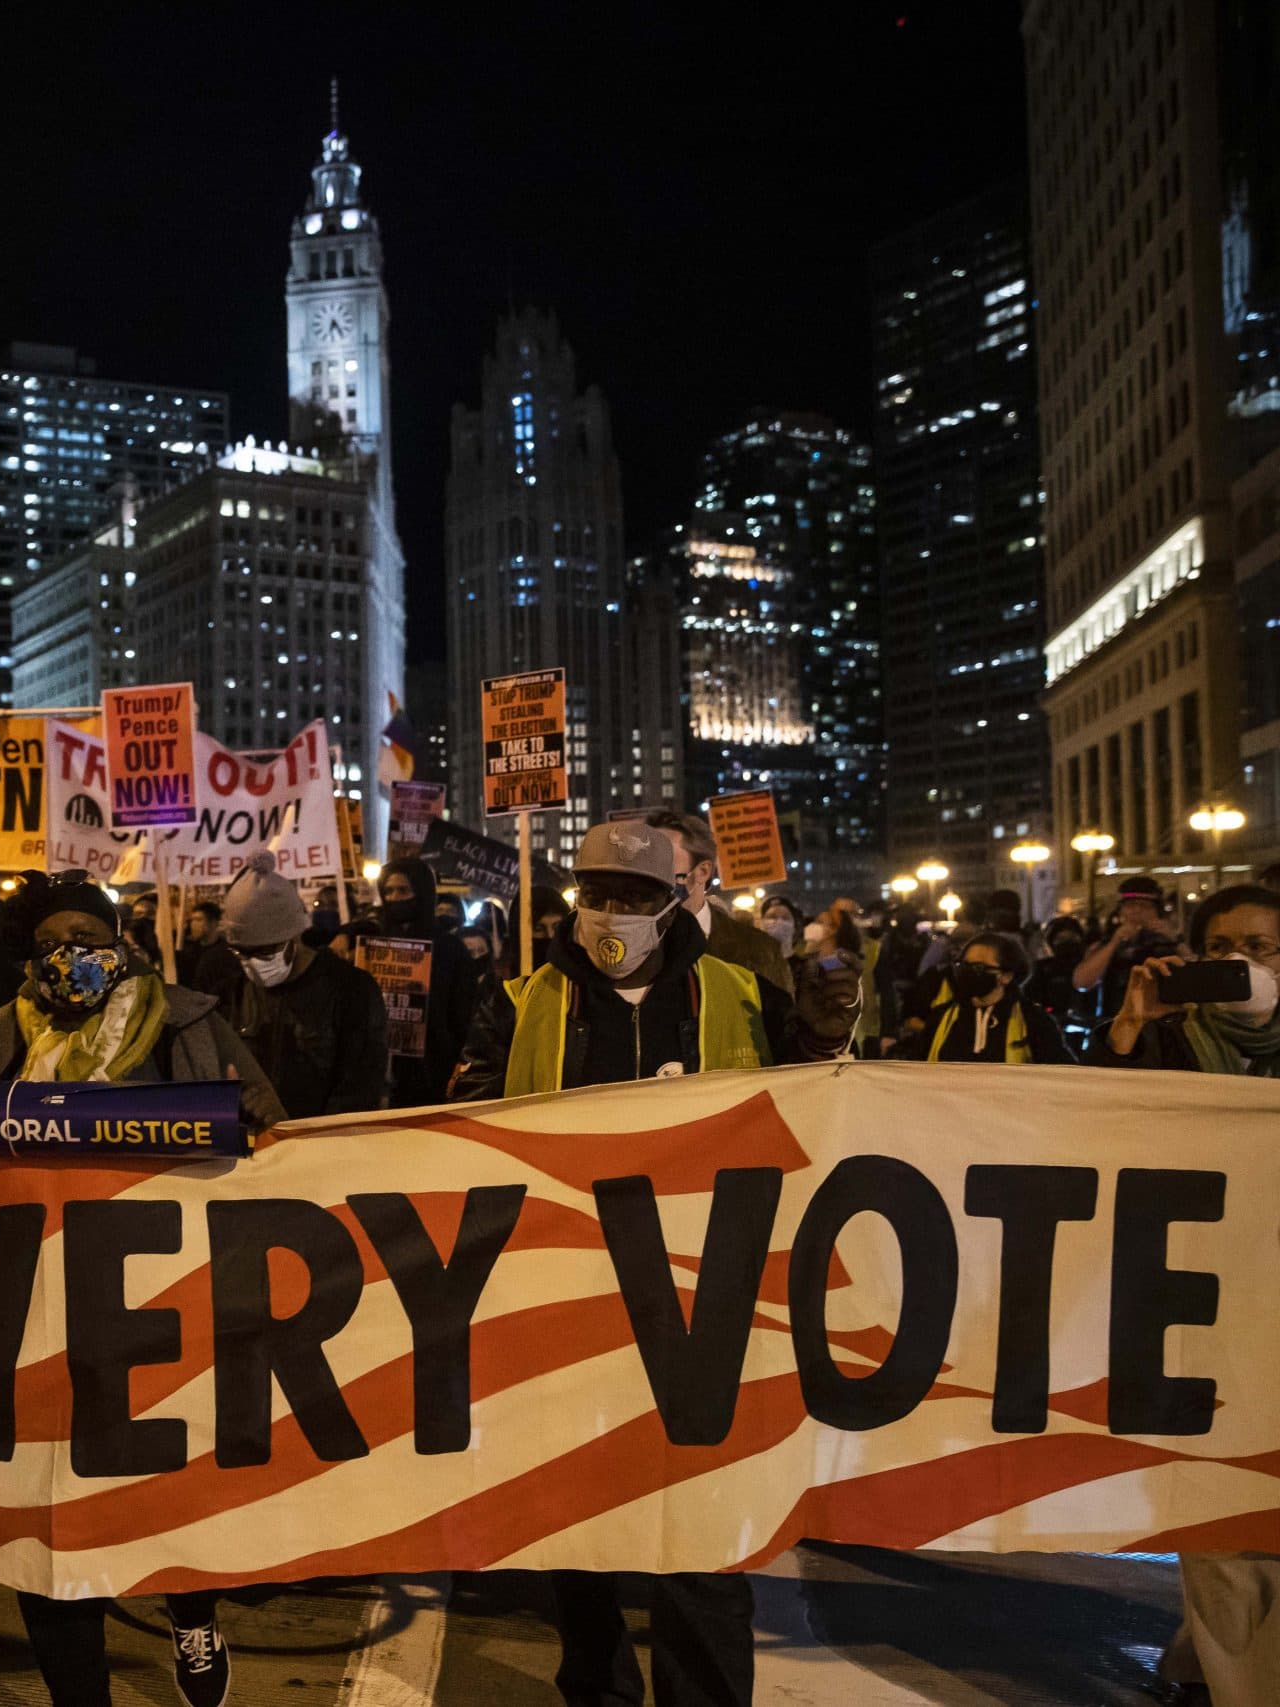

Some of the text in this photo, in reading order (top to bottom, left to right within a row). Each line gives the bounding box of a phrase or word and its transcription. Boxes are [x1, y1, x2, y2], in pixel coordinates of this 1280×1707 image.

[114, 691, 181, 715] Trump/
[520, 683, 555, 702] TRUMP
[120, 718, 178, 737] Pence
[124, 738, 178, 772] OUT
[501, 737, 545, 756] TAKE TO
[208, 730, 319, 797] OUT!
[489, 751, 560, 774] THE STREETS!
[115, 773, 190, 808] NOW!
[493, 785, 517, 805] OUT
[194, 797, 303, 845] NOW!
[54, 842, 79, 865] LL
[177, 853, 221, 876] THE
[230, 845, 330, 876] PPLE!
[493, 854, 520, 877] LIV
[90, 1119, 212, 1145] JUSTICE
[592, 1154, 1228, 1447] VOTE
